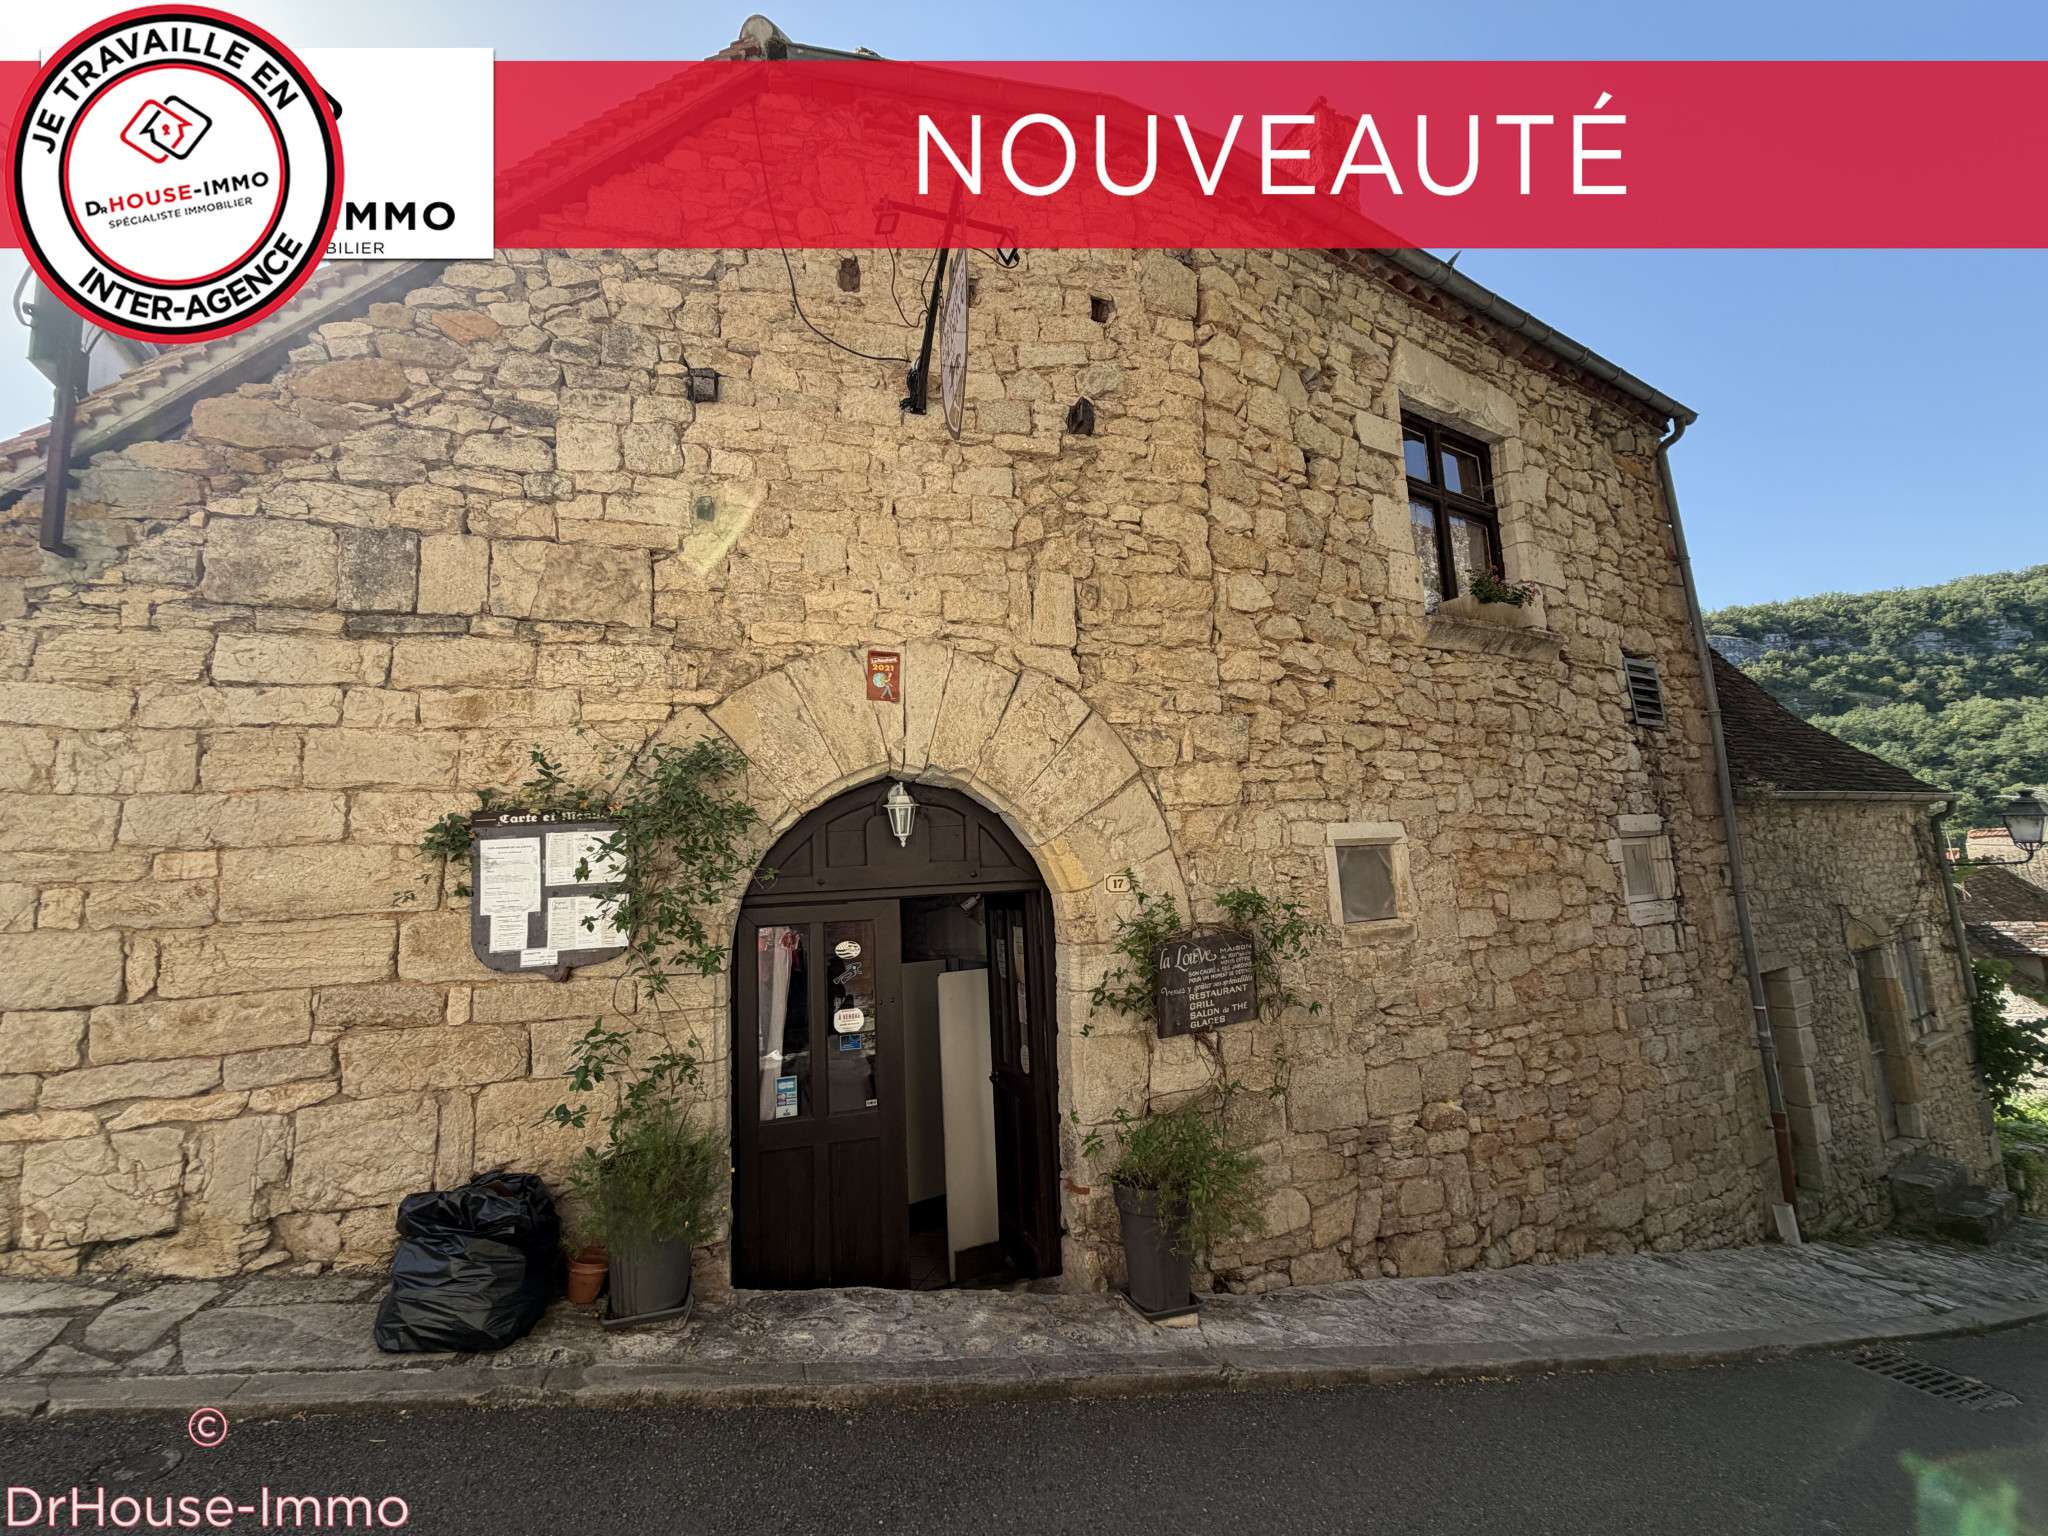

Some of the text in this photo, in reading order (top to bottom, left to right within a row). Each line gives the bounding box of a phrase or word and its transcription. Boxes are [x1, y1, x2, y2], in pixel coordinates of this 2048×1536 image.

[499, 814, 538, 824] Carte
[1112, 879, 1124, 889] 17
[1220, 943, 1252, 954] MAISON
[1188, 984, 1248, 1001] RESTAURANT
[1189, 1000, 1215, 1010] GRILL
[1189, 1008, 1220, 1020] SALON
[1190, 1015, 1226, 1029] GLACES
